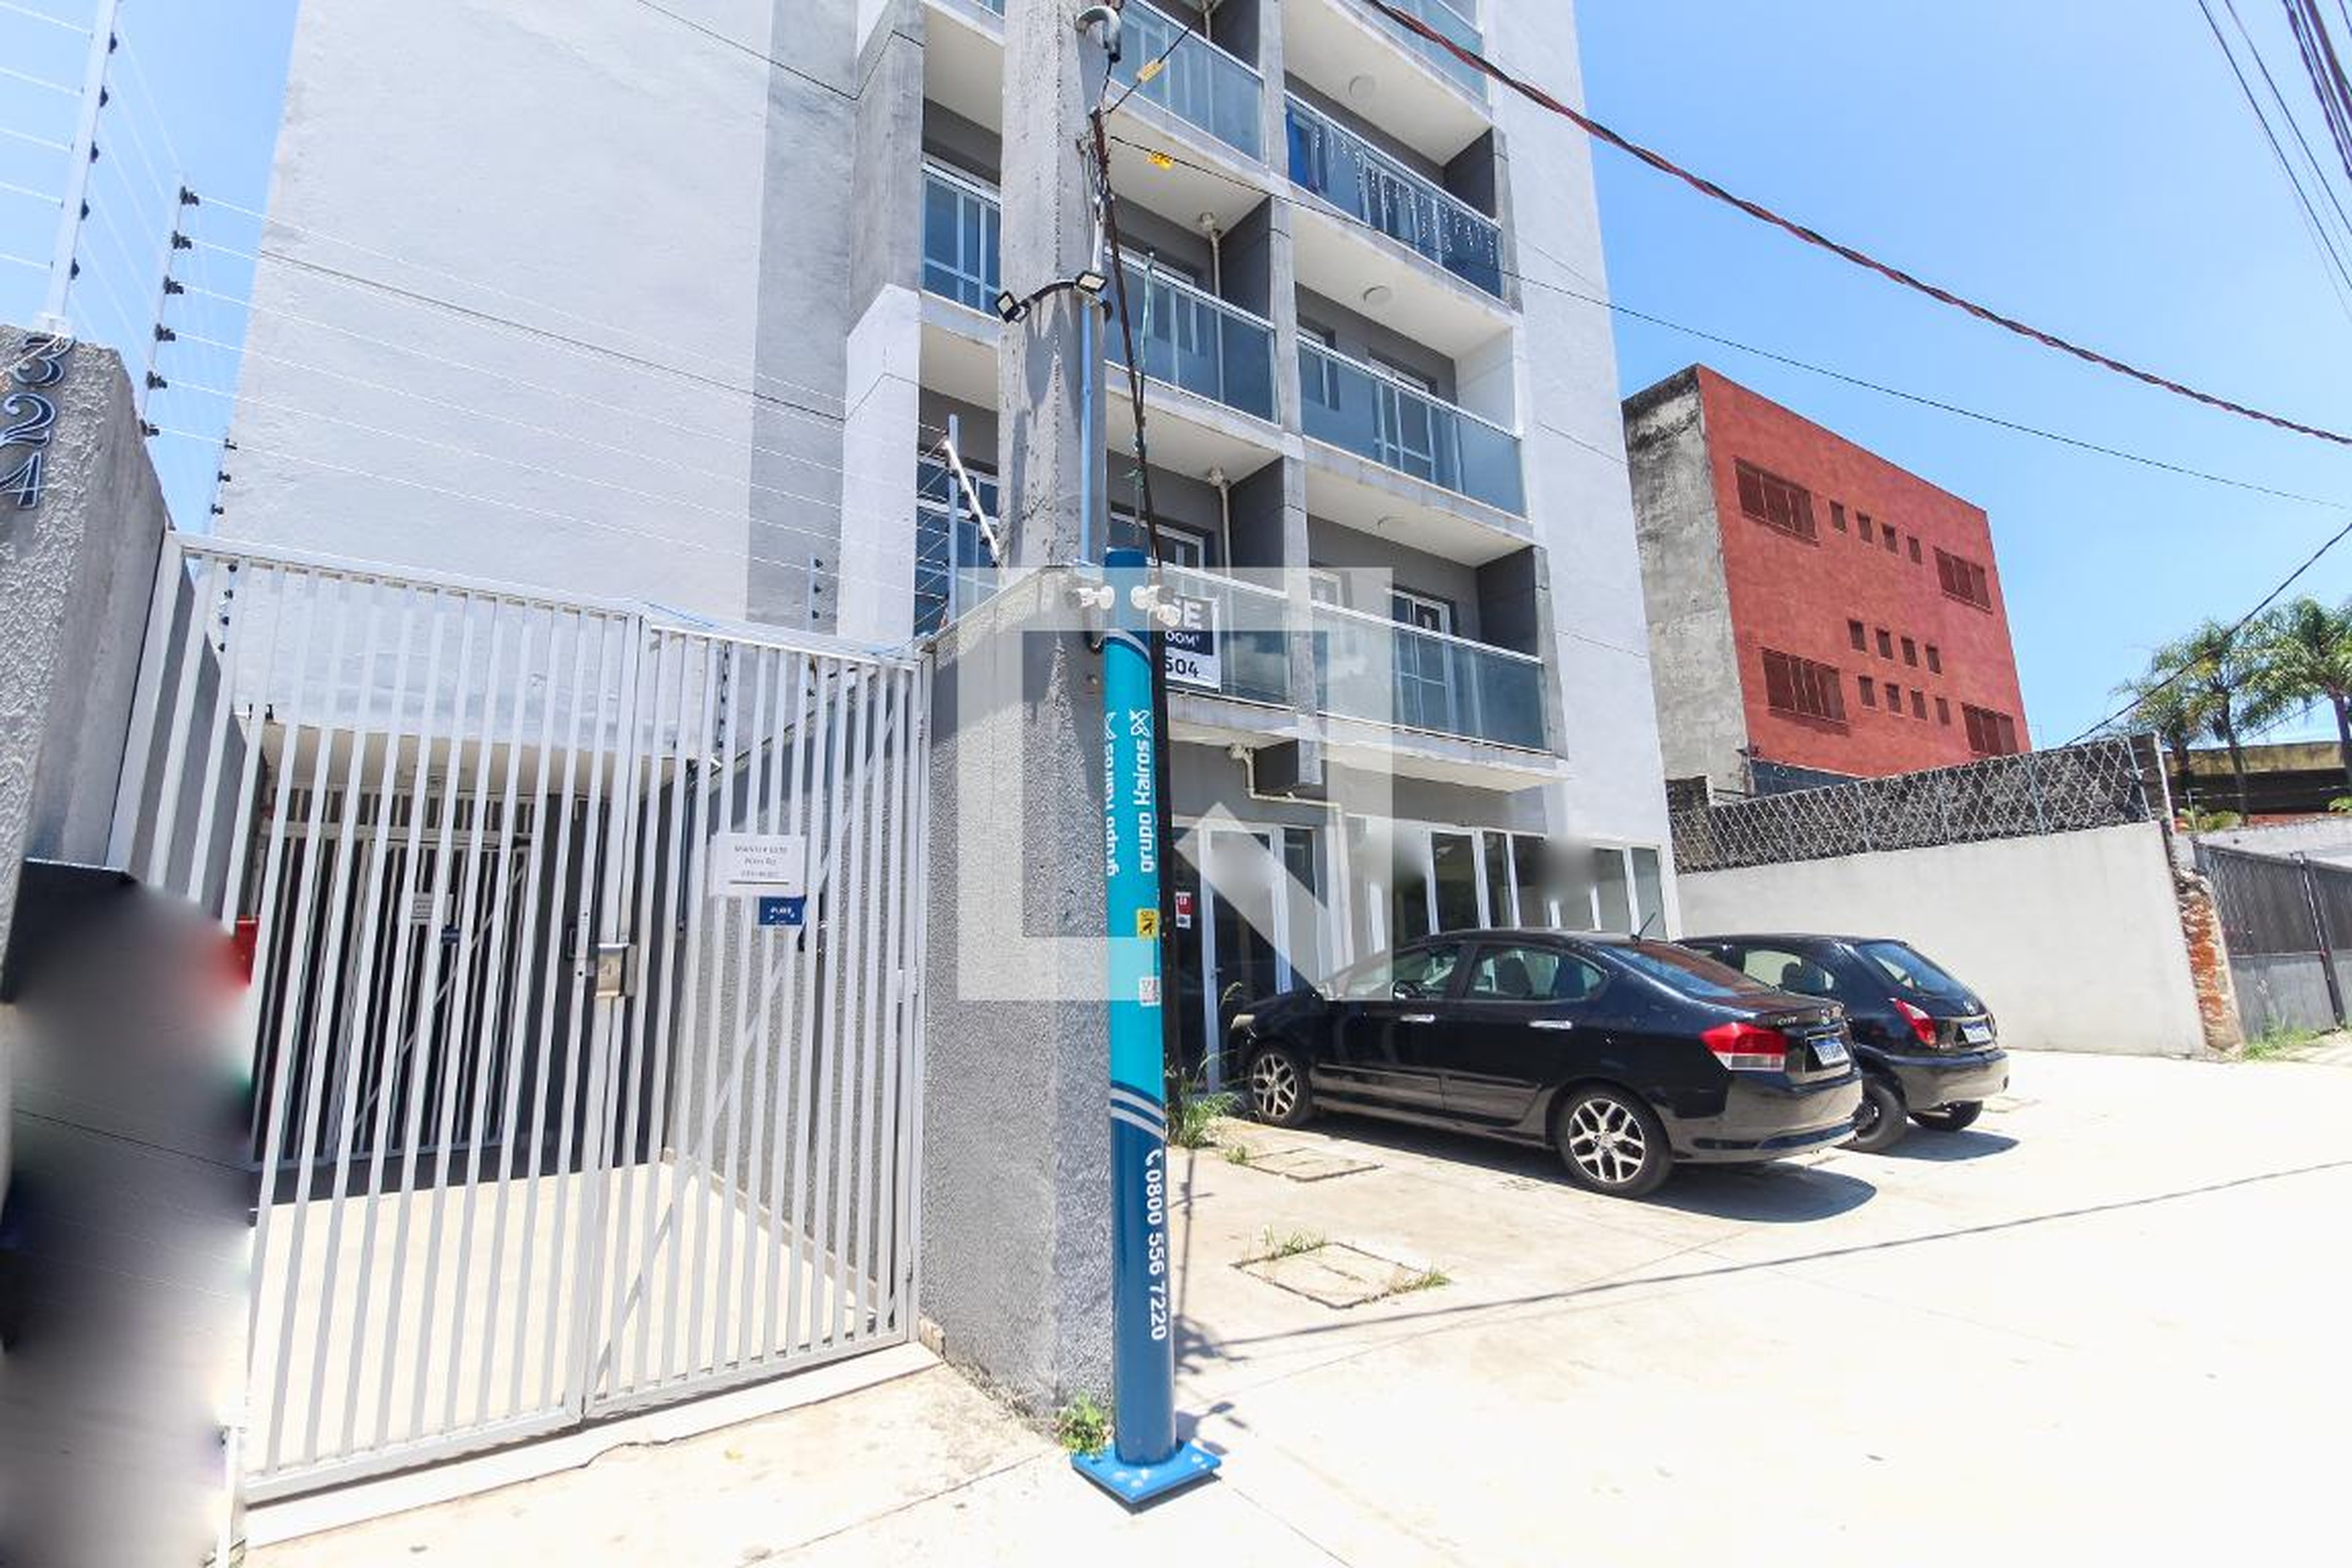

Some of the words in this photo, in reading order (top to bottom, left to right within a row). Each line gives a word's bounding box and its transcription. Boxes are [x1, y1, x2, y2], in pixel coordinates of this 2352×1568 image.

[1133, 739, 1151, 805] Kairos
[1138, 812, 1155, 873] grupo
[1145, 1169, 1163, 1226] 0800
[1148, 1232, 1165, 1276] 556
[1149, 1280, 1167, 1341] 7220
